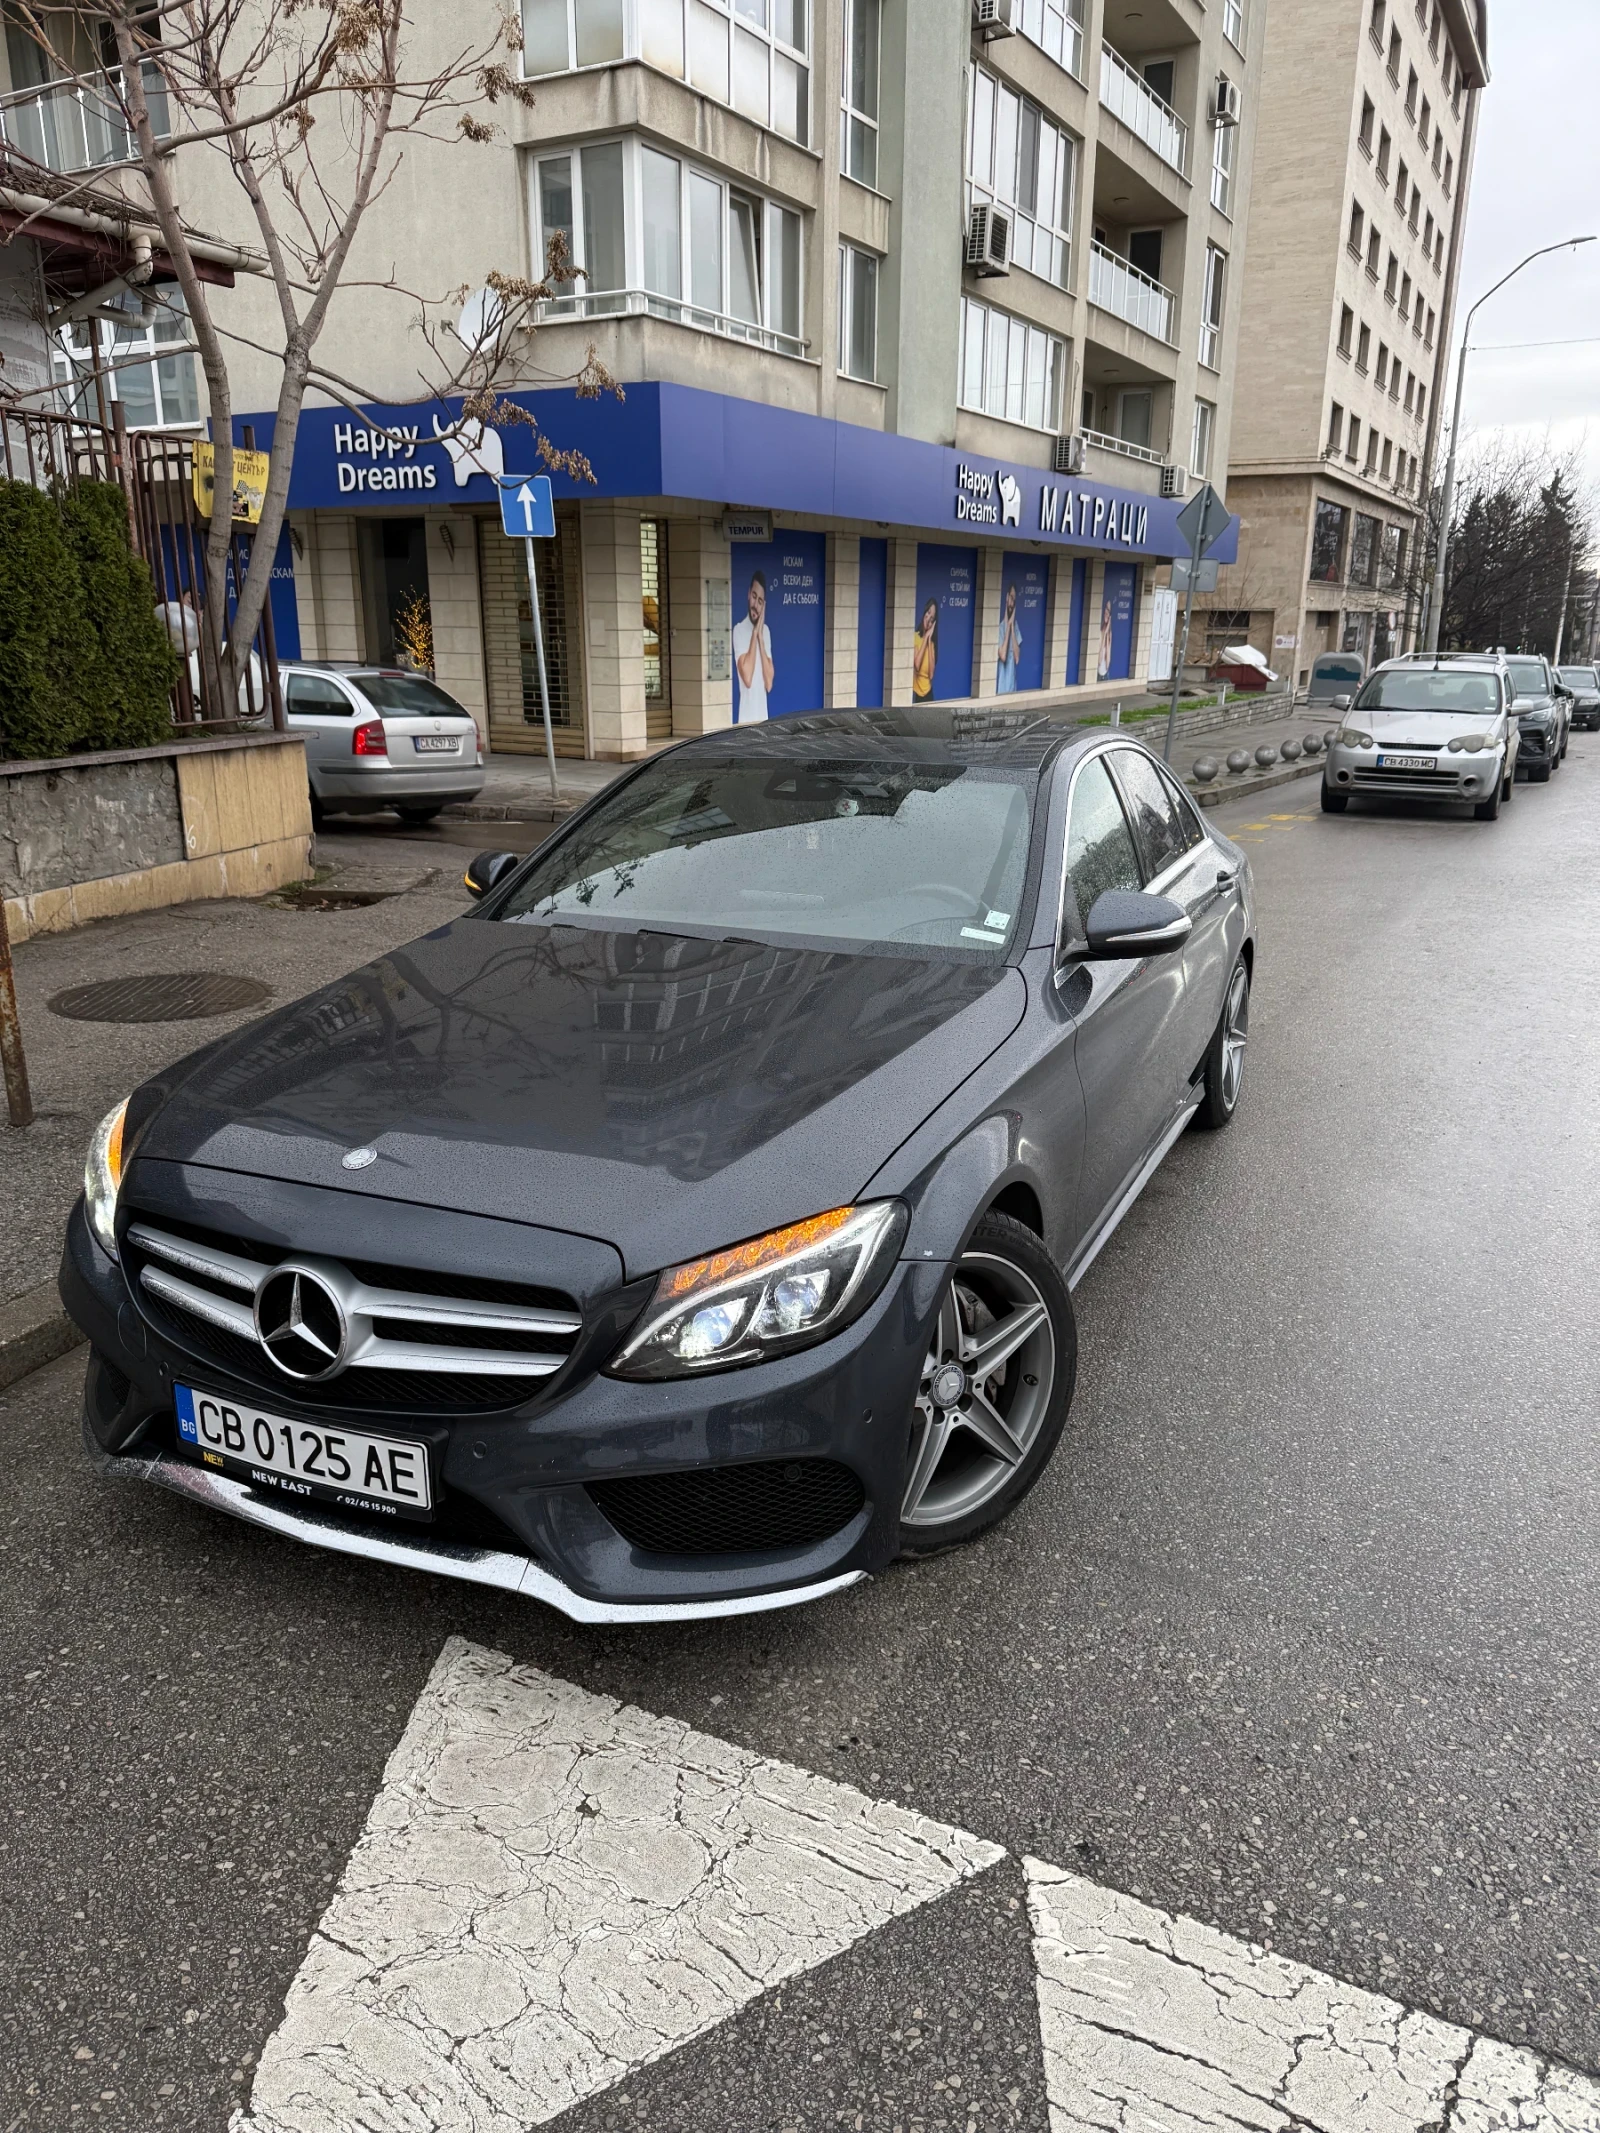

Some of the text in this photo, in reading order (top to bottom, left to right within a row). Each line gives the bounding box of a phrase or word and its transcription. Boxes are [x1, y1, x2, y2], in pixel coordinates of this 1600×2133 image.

[333, 423, 419, 460] Happy
[236, 461, 266, 476] ЦЕНТЪР
[337, 462, 437, 492] Dreams
[958, 463, 994, 499] Happy
[957, 494, 998, 524] Dreams
[1039, 485, 1148, 546] МАТРАЦИ
[727, 526, 765, 536] TEMPUR
[783, 556, 804, 568] ИСКАМ
[783, 574, 813, 588] ВСЕКИ ДЕН
[783, 593, 792, 606] ДА
[1384, 757, 1397, 766] CB
[1398, 759, 1420, 768] 4330
[181, 1418, 195, 1434] BG
[199, 1400, 419, 1498] CB 0125 AE
[252, 1469, 312, 1496] NEW EAST
[381, 1504, 397, 1514] 900
